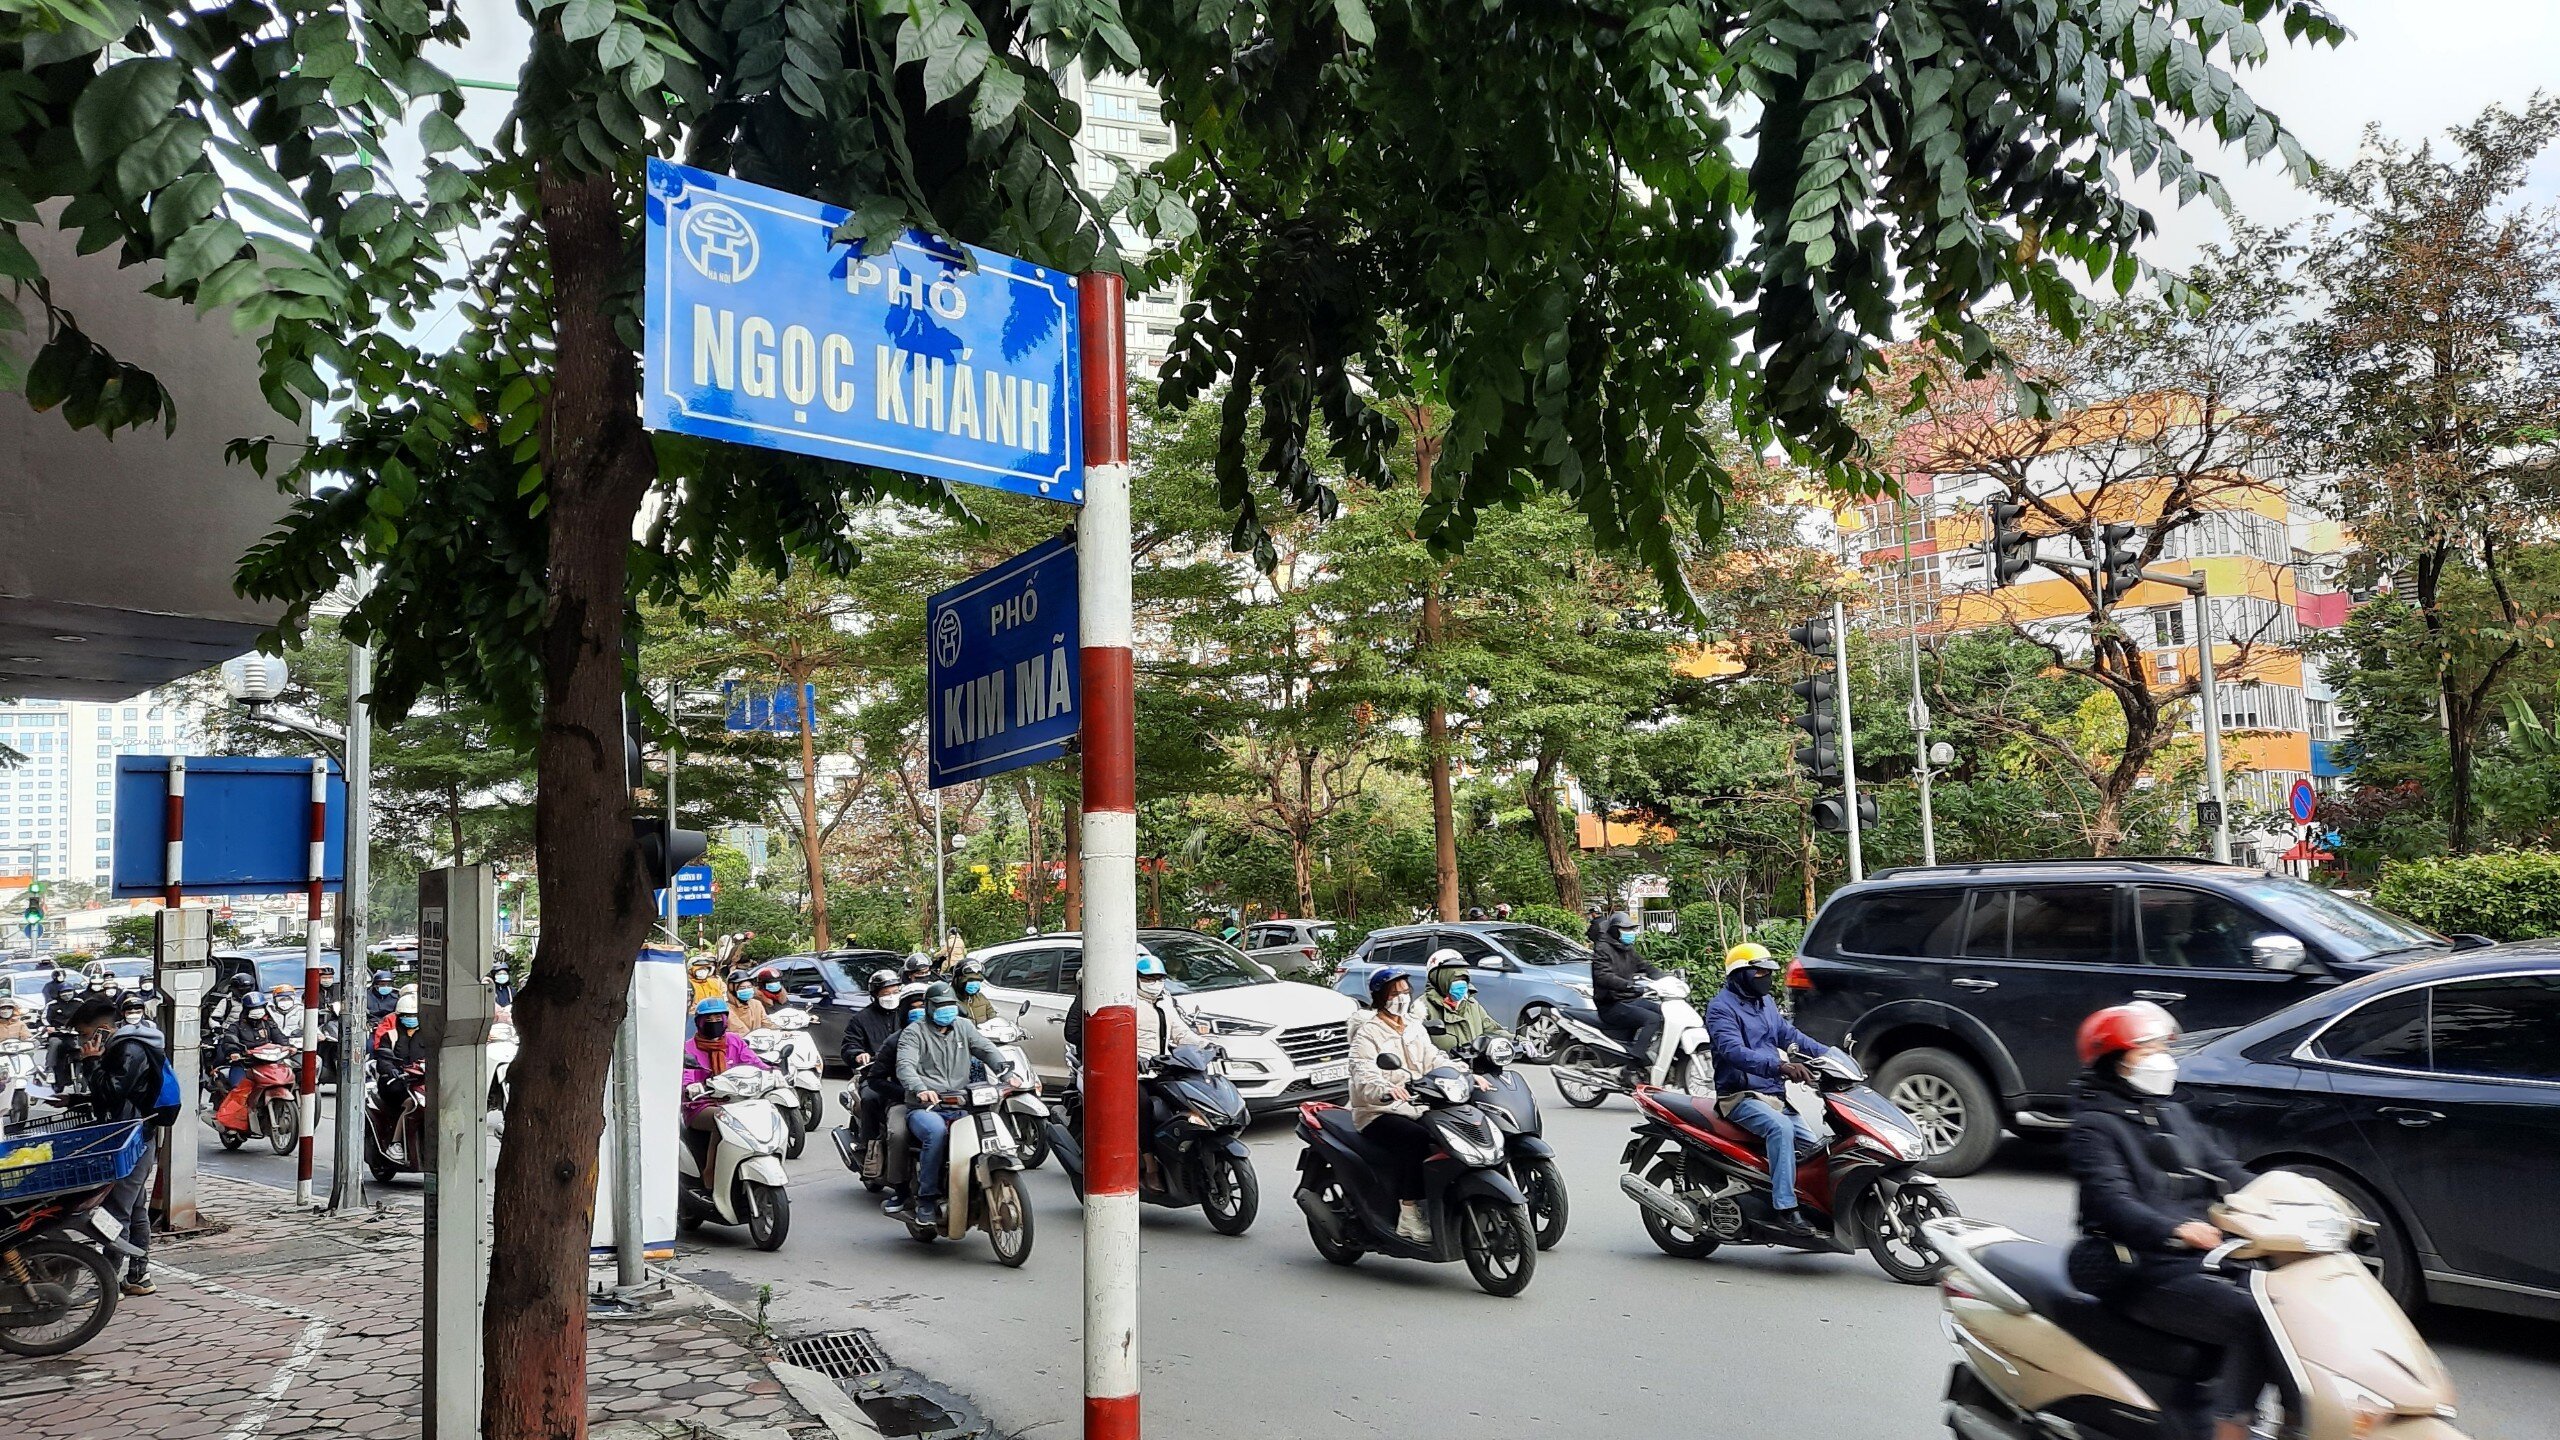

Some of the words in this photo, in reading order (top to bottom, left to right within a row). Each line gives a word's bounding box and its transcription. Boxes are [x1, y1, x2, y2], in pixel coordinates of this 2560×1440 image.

[846, 256, 970, 320] PHỐ
[694, 304, 856, 424] NGỌC
[876, 344, 1050, 454] KHÁNH
[991, 569, 1040, 637] PHỐ
[944, 669, 1005, 749] KIM
[1015, 631, 1072, 728] MÃ
